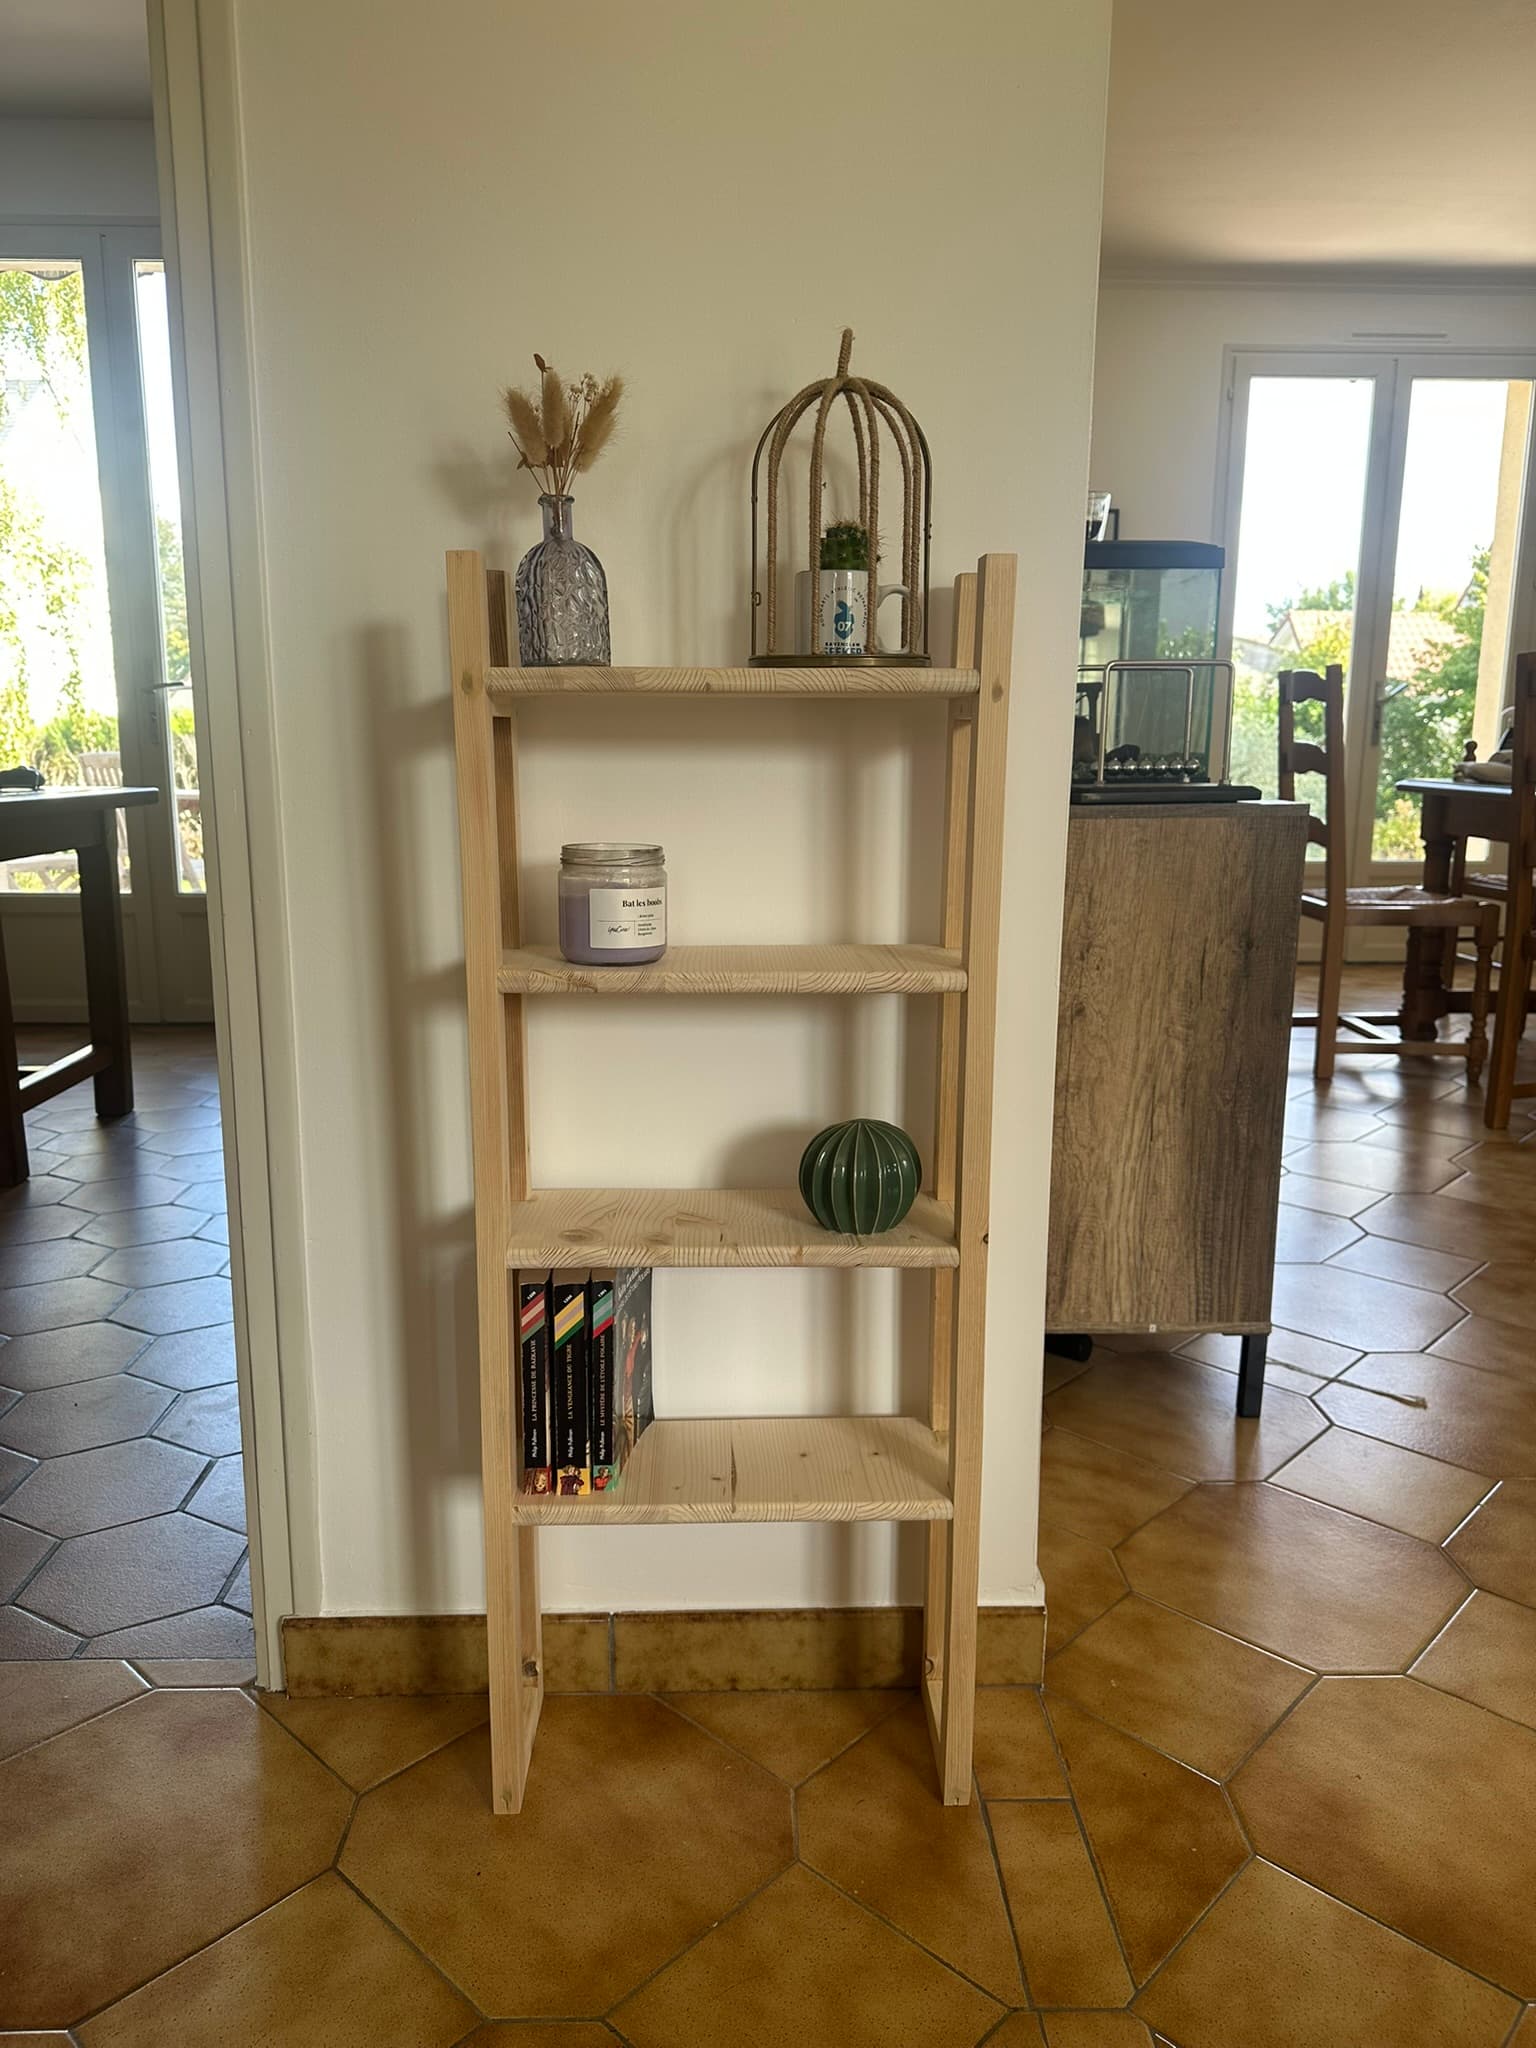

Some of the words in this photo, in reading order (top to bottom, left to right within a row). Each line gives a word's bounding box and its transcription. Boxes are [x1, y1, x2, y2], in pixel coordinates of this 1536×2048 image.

[837, 621, 852, 631] 07
[622, 900, 635, 908] Bat
[636, 899, 646, 907] les
[530, 1369, 537, 1379] DE
[566, 1373, 574, 1411] VENGEANCE
[531, 1413, 538, 1422] LA
[567, 1411, 574, 1420] LA
[599, 1418, 606, 1426] LE
